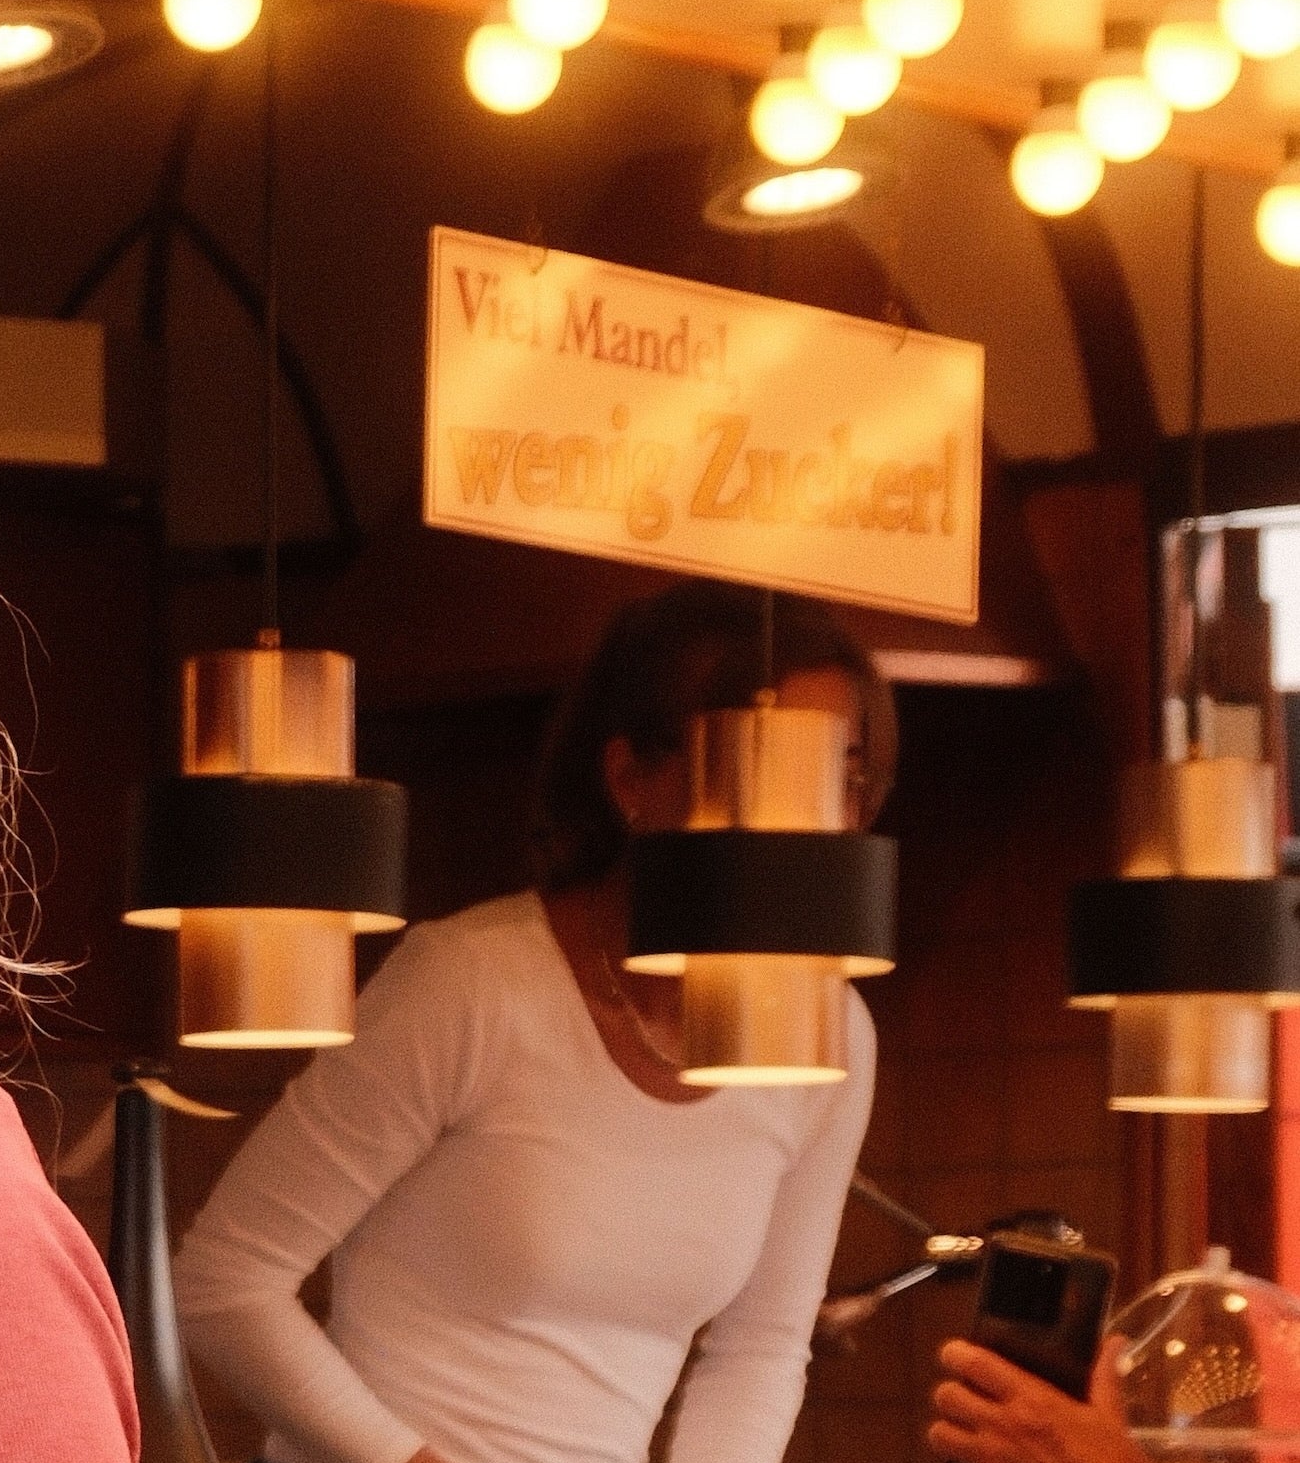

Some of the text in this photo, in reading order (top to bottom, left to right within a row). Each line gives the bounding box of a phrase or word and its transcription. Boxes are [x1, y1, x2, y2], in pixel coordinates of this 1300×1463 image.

[453, 266, 542, 348] Viel
[448, 403, 961, 540] wenig Zucker!
